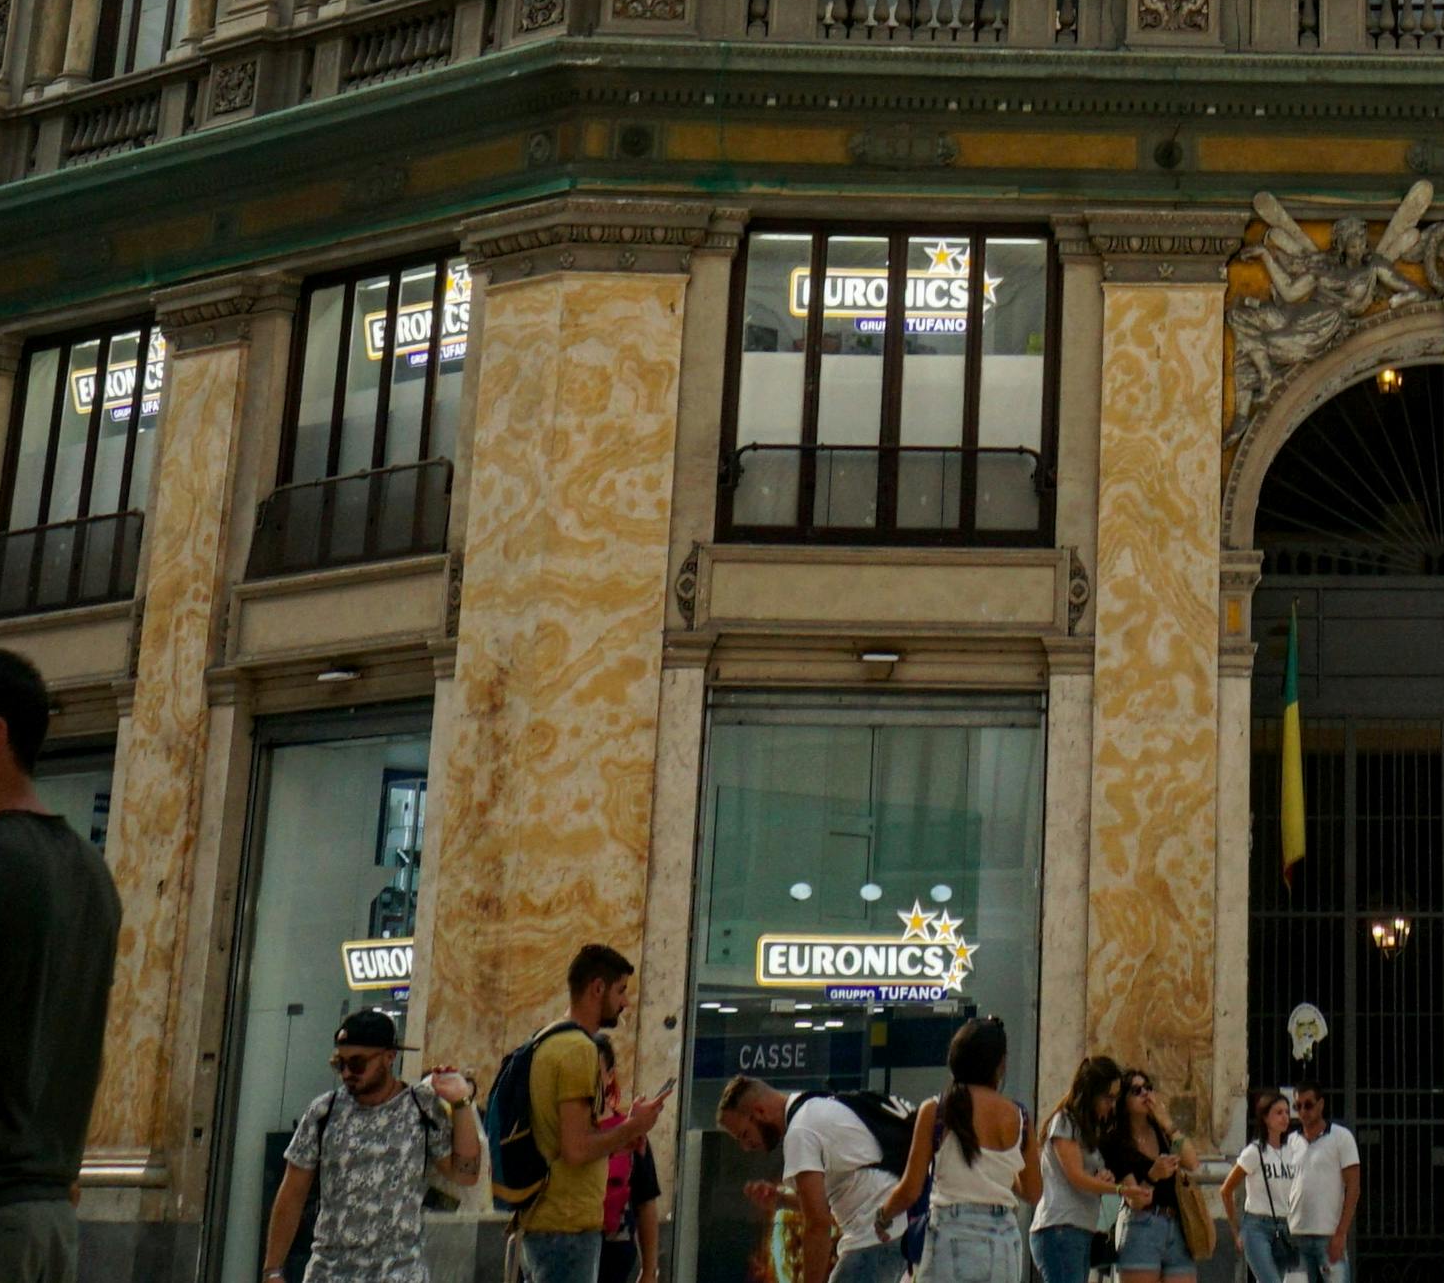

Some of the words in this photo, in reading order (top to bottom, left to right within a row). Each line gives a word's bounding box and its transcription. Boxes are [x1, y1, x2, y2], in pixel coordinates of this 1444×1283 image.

[907, 318, 967, 332] TUFANO
[768, 944, 945, 976] EURONICS
[830, 988, 876, 1000] GRUPPO
[878, 985, 943, 1000] TUFANO
[739, 1043, 806, 1070] CASSE
[1264, 1163, 1296, 1180] BLAC
